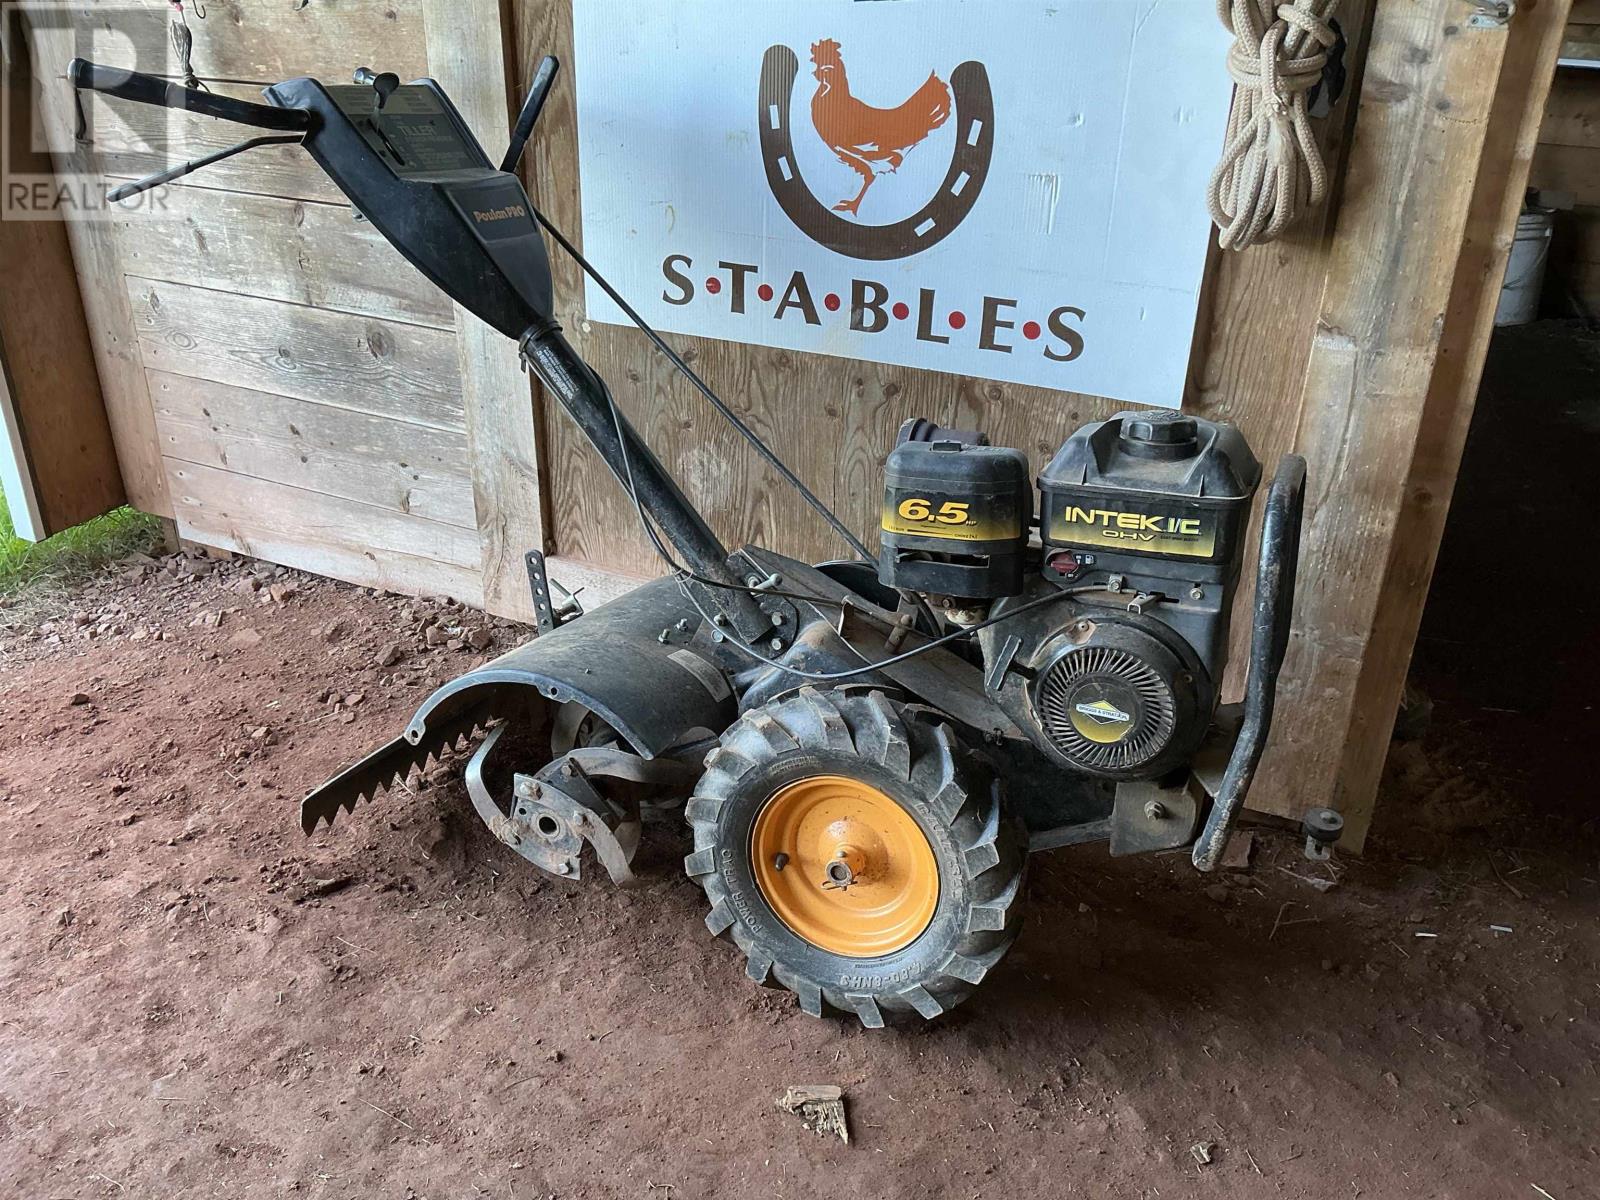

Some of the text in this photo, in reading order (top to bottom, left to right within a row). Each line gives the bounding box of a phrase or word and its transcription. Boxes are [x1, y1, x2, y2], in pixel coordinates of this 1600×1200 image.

[473, 205, 526, 223] Poulan PRO
[898, 498, 970, 525] 6.5
[1065, 506, 1166, 532] INTEK
[1102, 529, 1156, 542] OHV
[731, 888, 763, 934] POWER
